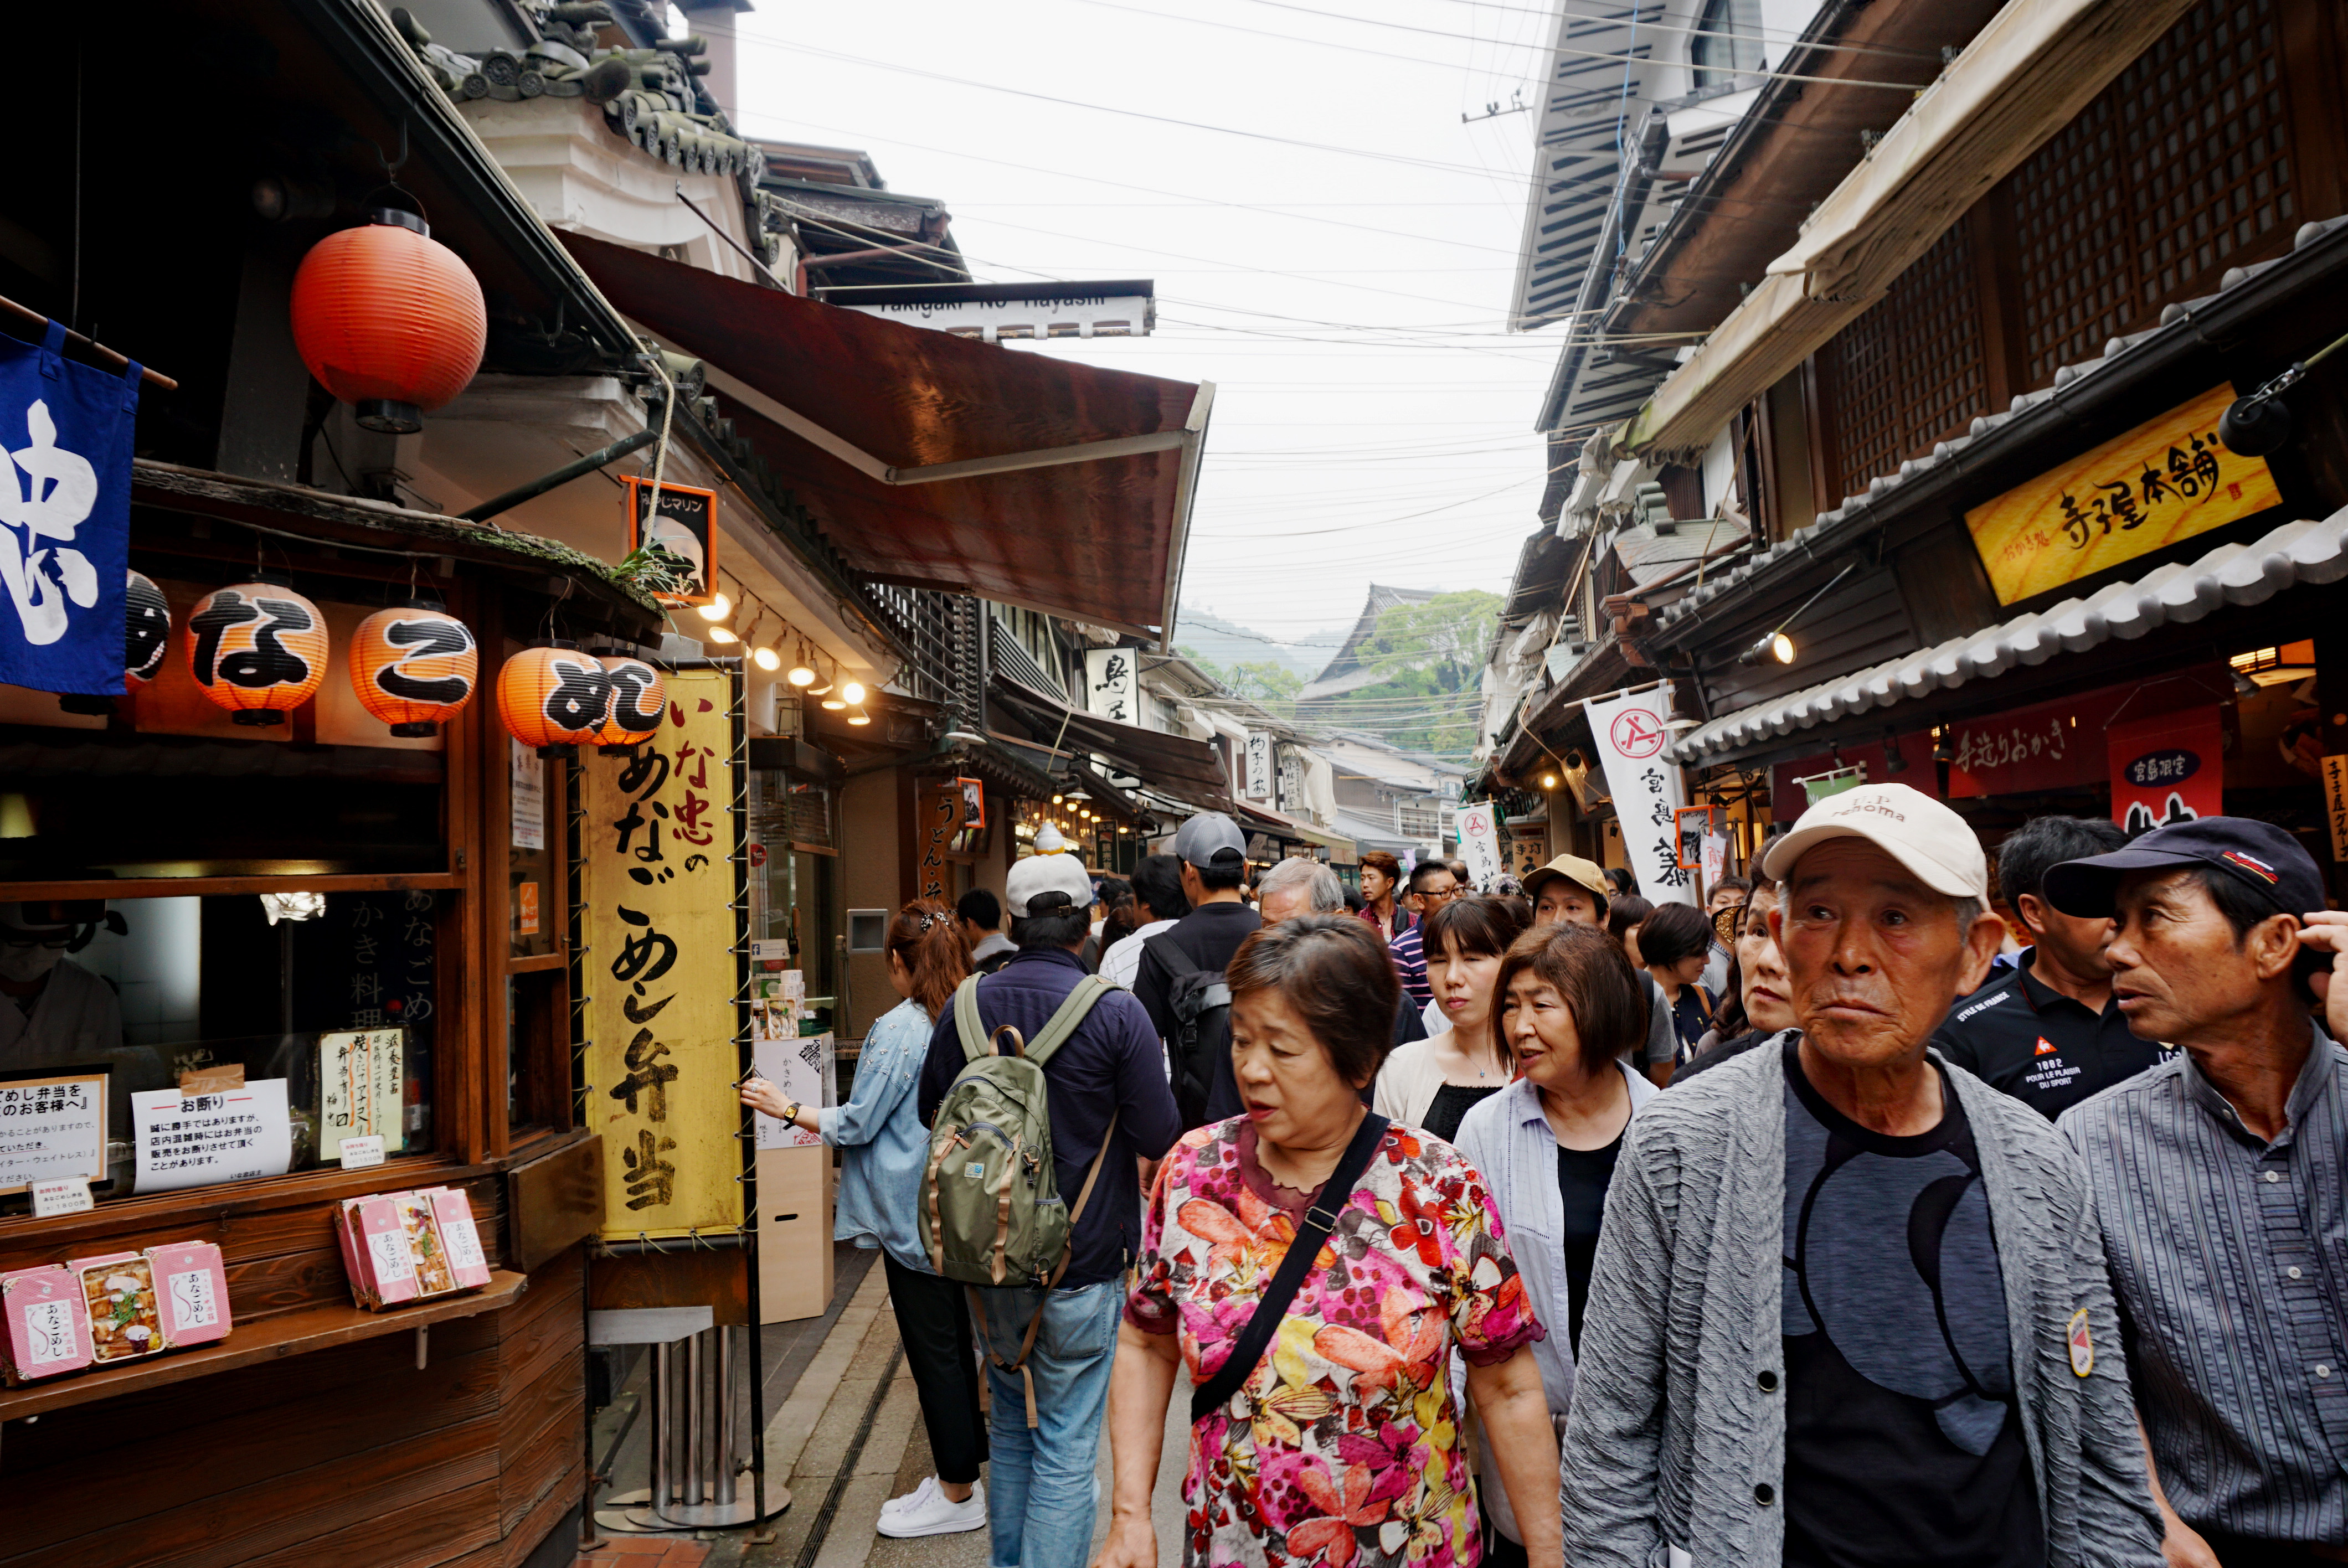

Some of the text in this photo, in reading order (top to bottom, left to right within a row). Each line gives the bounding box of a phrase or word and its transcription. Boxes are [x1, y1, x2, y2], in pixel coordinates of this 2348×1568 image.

[2058, 432, 2218, 550] 寺子屋本舗
[189, 591, 313, 688] な
[1955, 718, 2066, 773] 手造りおかき
[1249, 736, 1265, 795] 杓子の家
[2134, 754, 2185, 781] 宮島限定
[670, 698, 714, 872] いな忠の
[922, 798, 957, 916] うどん・そ
[1957, 991, 2011, 1022] STYLE DE FRANCE
[2026, 1074, 2047, 1084] POUR
[2055, 1066, 2082, 1077] PLAISIR
[2037, 1058, 2064, 1071] 1882
[2039, 1077, 2072, 1089] DU SPORT
[0, 1097, 87, 1117] のお客様へ』
[181, 1095, 224, 1113] お断り
[150, 1113, 259, 1133] 誠に勝手ではありますが、
[150, 1126, 262, 1146] 店内混雑時にはお弁当の
[151, 1138, 254, 1159] 販売をお断りさせて頂く
[151, 1156, 219, 1171] ことがあります。
[44, 1192, 83, 1202] あなごめし弁当
[188, 1273, 204, 1323] あなごめし
[47, 1304, 63, 1356] あなごめし
